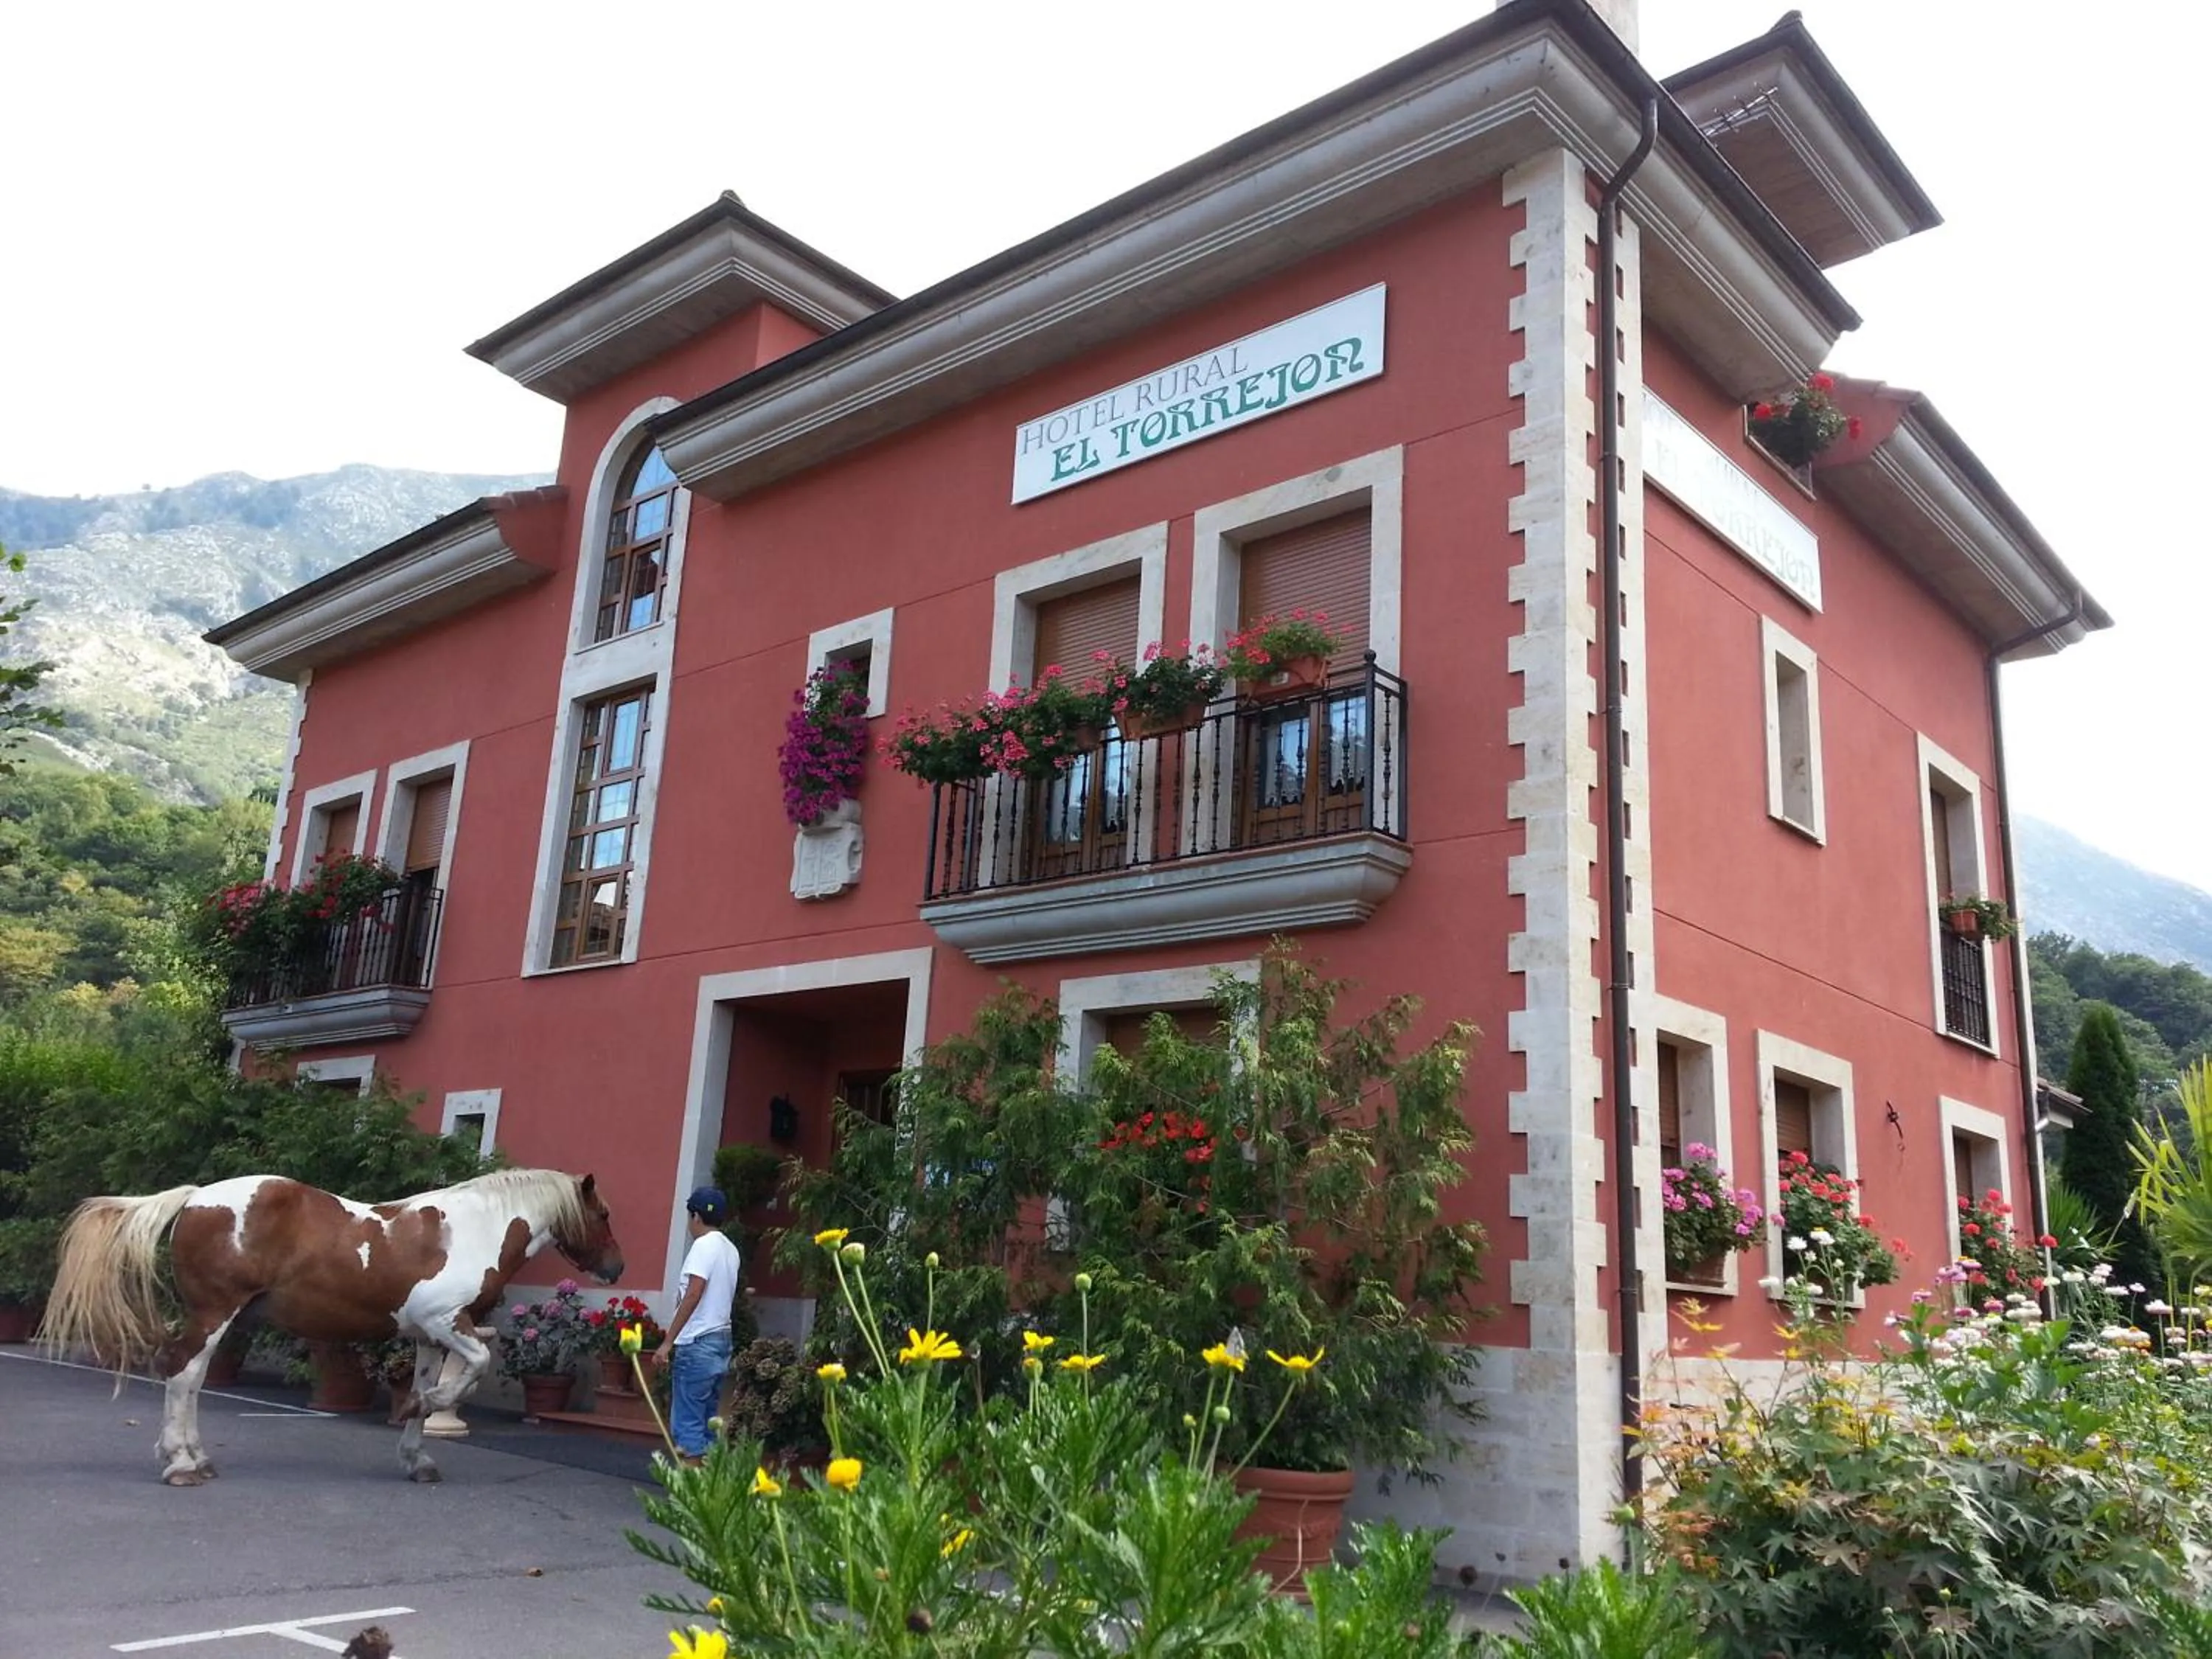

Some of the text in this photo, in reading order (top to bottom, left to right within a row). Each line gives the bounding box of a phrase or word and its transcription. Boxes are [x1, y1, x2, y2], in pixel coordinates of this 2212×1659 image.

[1023, 347, 1248, 455] HOTEL RURAL
[1051, 337, 1364, 481] EL TORREJON
